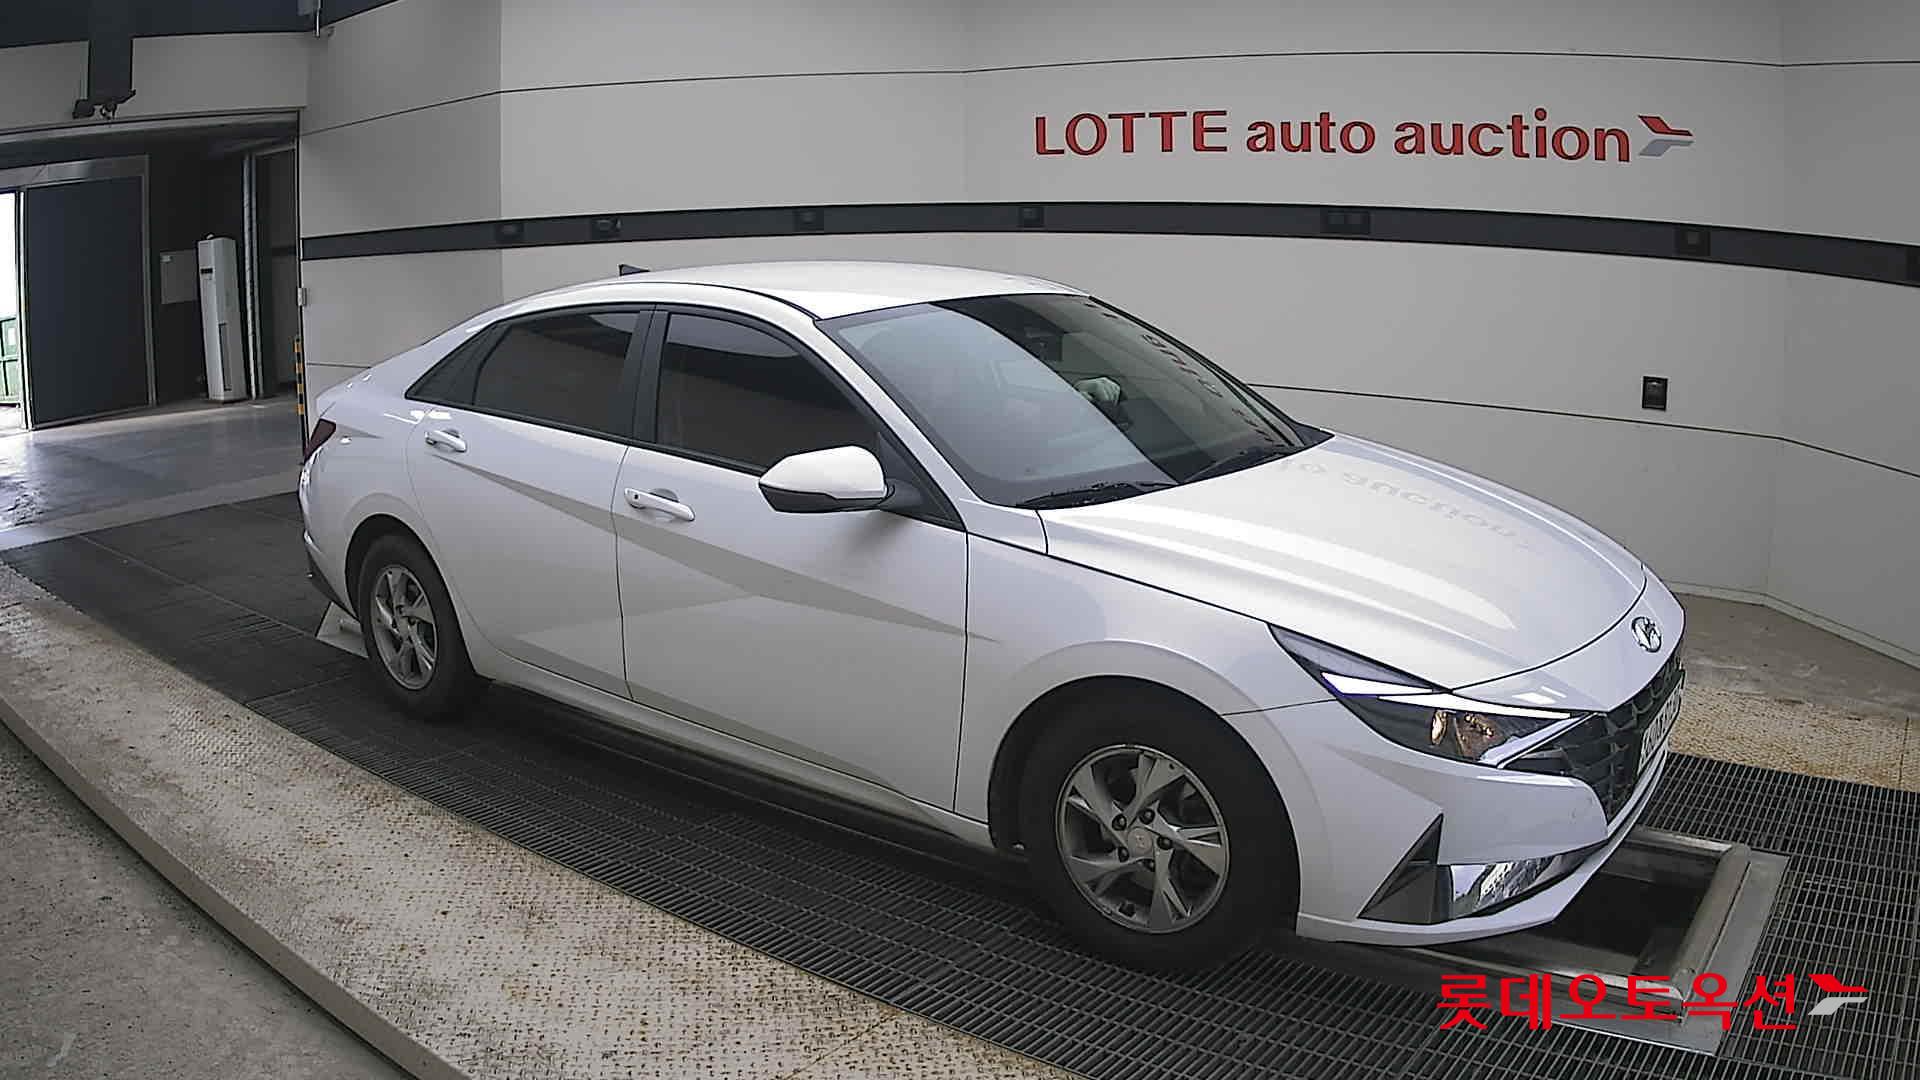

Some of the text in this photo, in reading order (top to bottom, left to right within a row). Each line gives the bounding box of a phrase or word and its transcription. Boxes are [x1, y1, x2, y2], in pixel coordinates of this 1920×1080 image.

[1035, 108, 1630, 162] LOTTE auto auction
